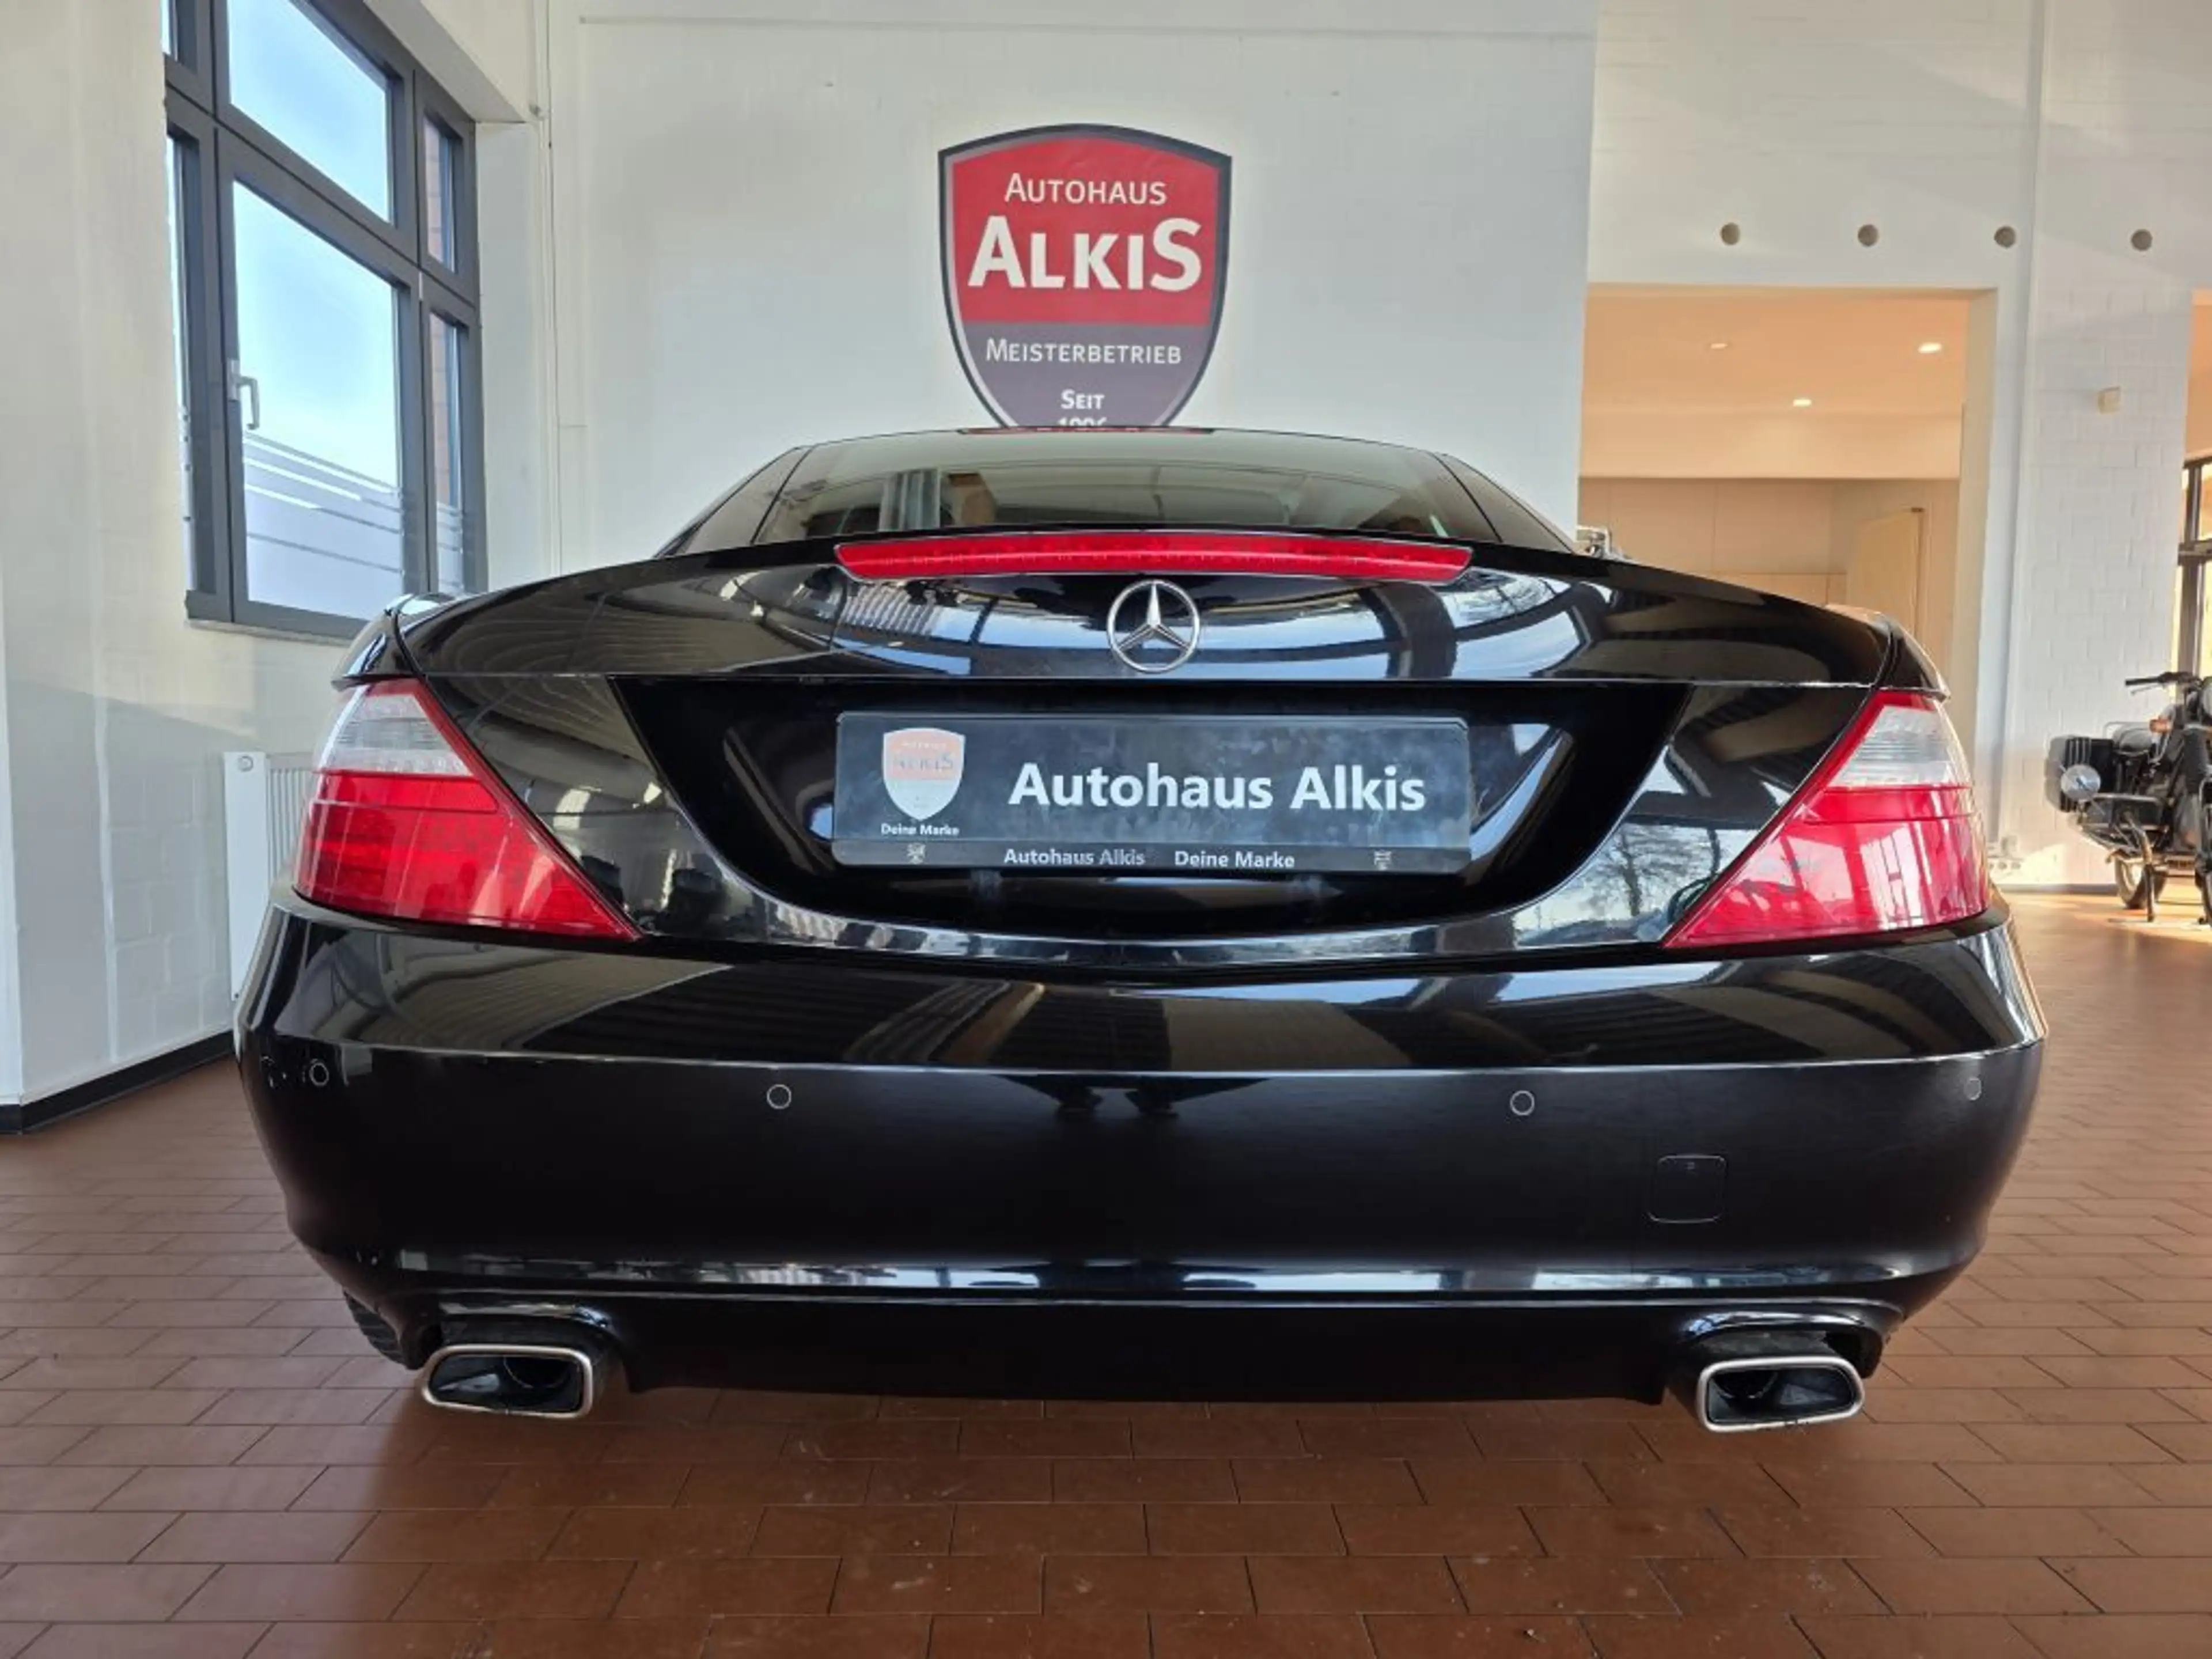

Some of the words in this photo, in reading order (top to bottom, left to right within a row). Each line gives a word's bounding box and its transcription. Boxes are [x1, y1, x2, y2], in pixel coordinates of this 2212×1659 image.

[1005, 173, 1167, 206] AUTOHAUS
[968, 215, 1202, 292] ALKIS
[986, 338, 1181, 364] MEISTERBETRIEB
[1060, 389, 1105, 410] SEIT
[1008, 762, 1274, 809] Autohaus
[1290, 764, 1426, 810] Alkis
[881, 823, 916, 835] Deine
[920, 824, 959, 836] Marke
[1003, 848, 1094, 865] Autohaus
[1099, 849, 1146, 865] Alkis
[1175, 850, 1229, 867] Deine
[1235, 851, 1296, 868] Marke
